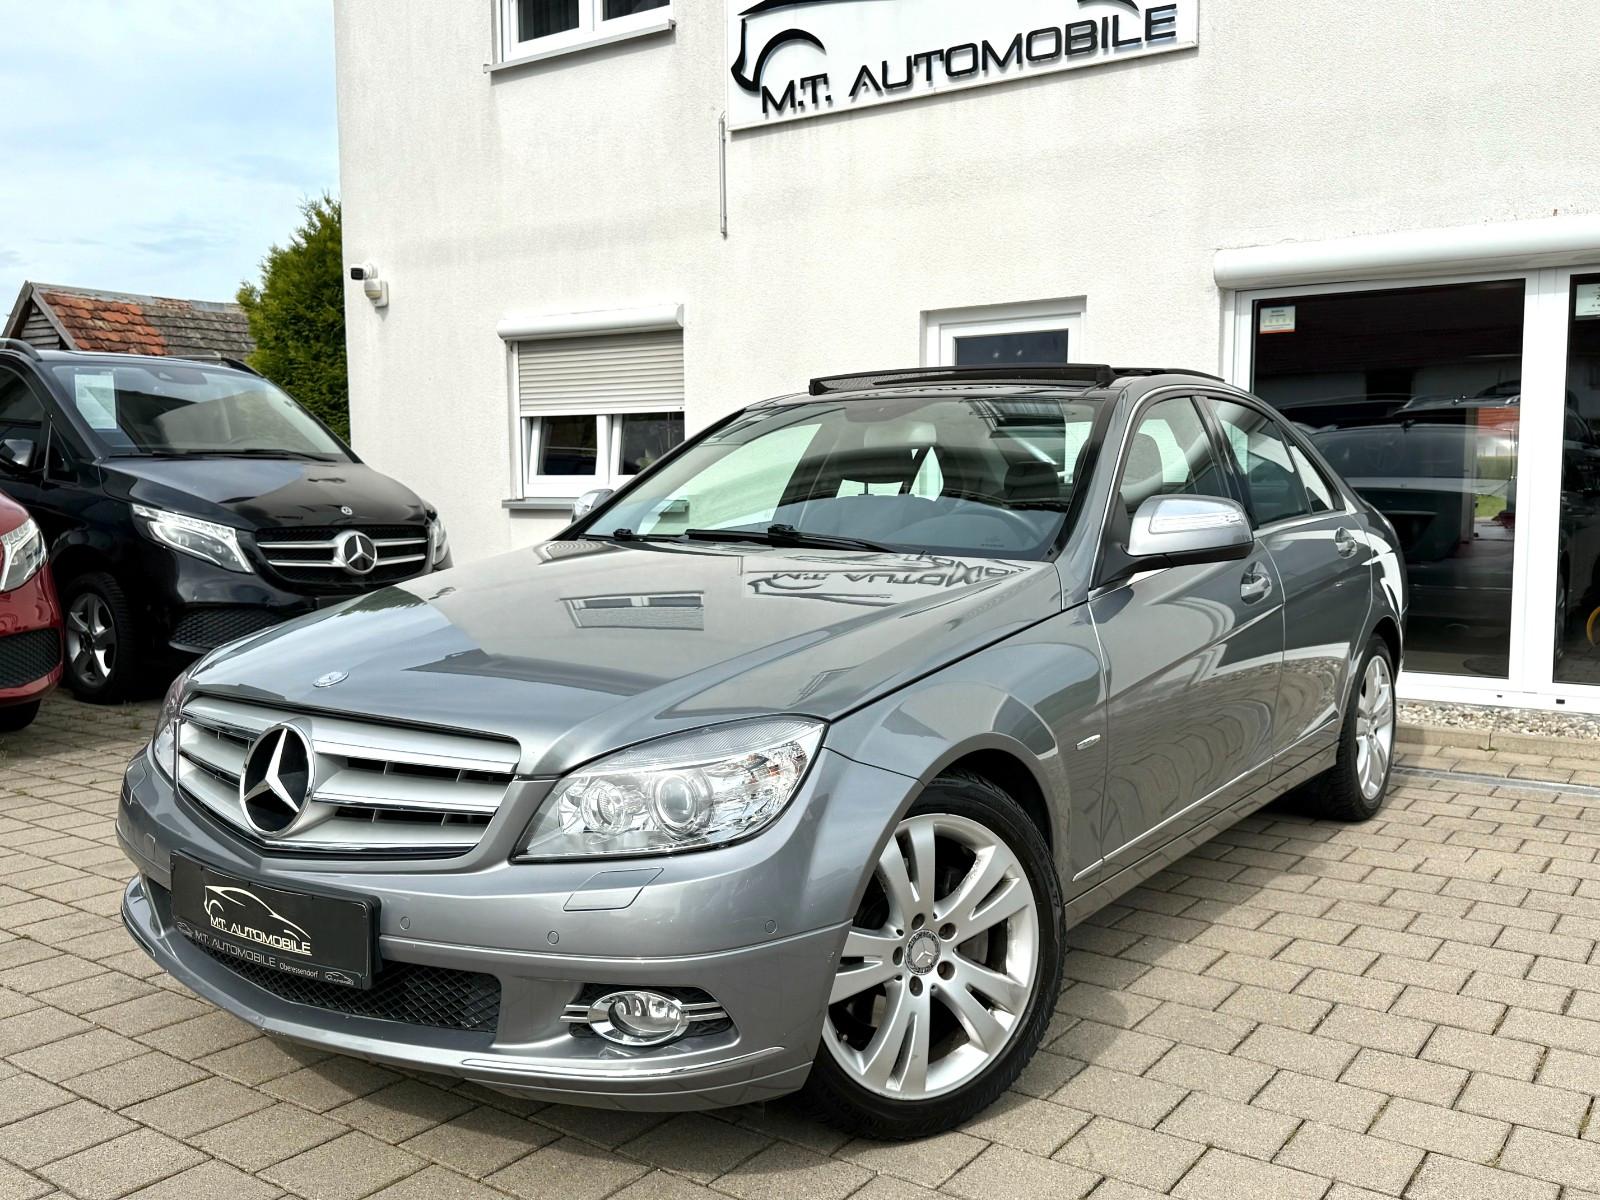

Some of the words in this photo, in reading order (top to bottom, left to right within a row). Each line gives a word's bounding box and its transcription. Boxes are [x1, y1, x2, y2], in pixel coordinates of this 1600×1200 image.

[762, 73, 832, 115] M.T.
[849, 4, 1177, 98] AUTOMOBILE
[211, 914, 228, 931] M.T.
[230, 922, 311, 954] AUTOMOBILE
[212, 938, 276, 967] AUTOMOBILE
[280, 962, 318, 978] Oberessendorf
